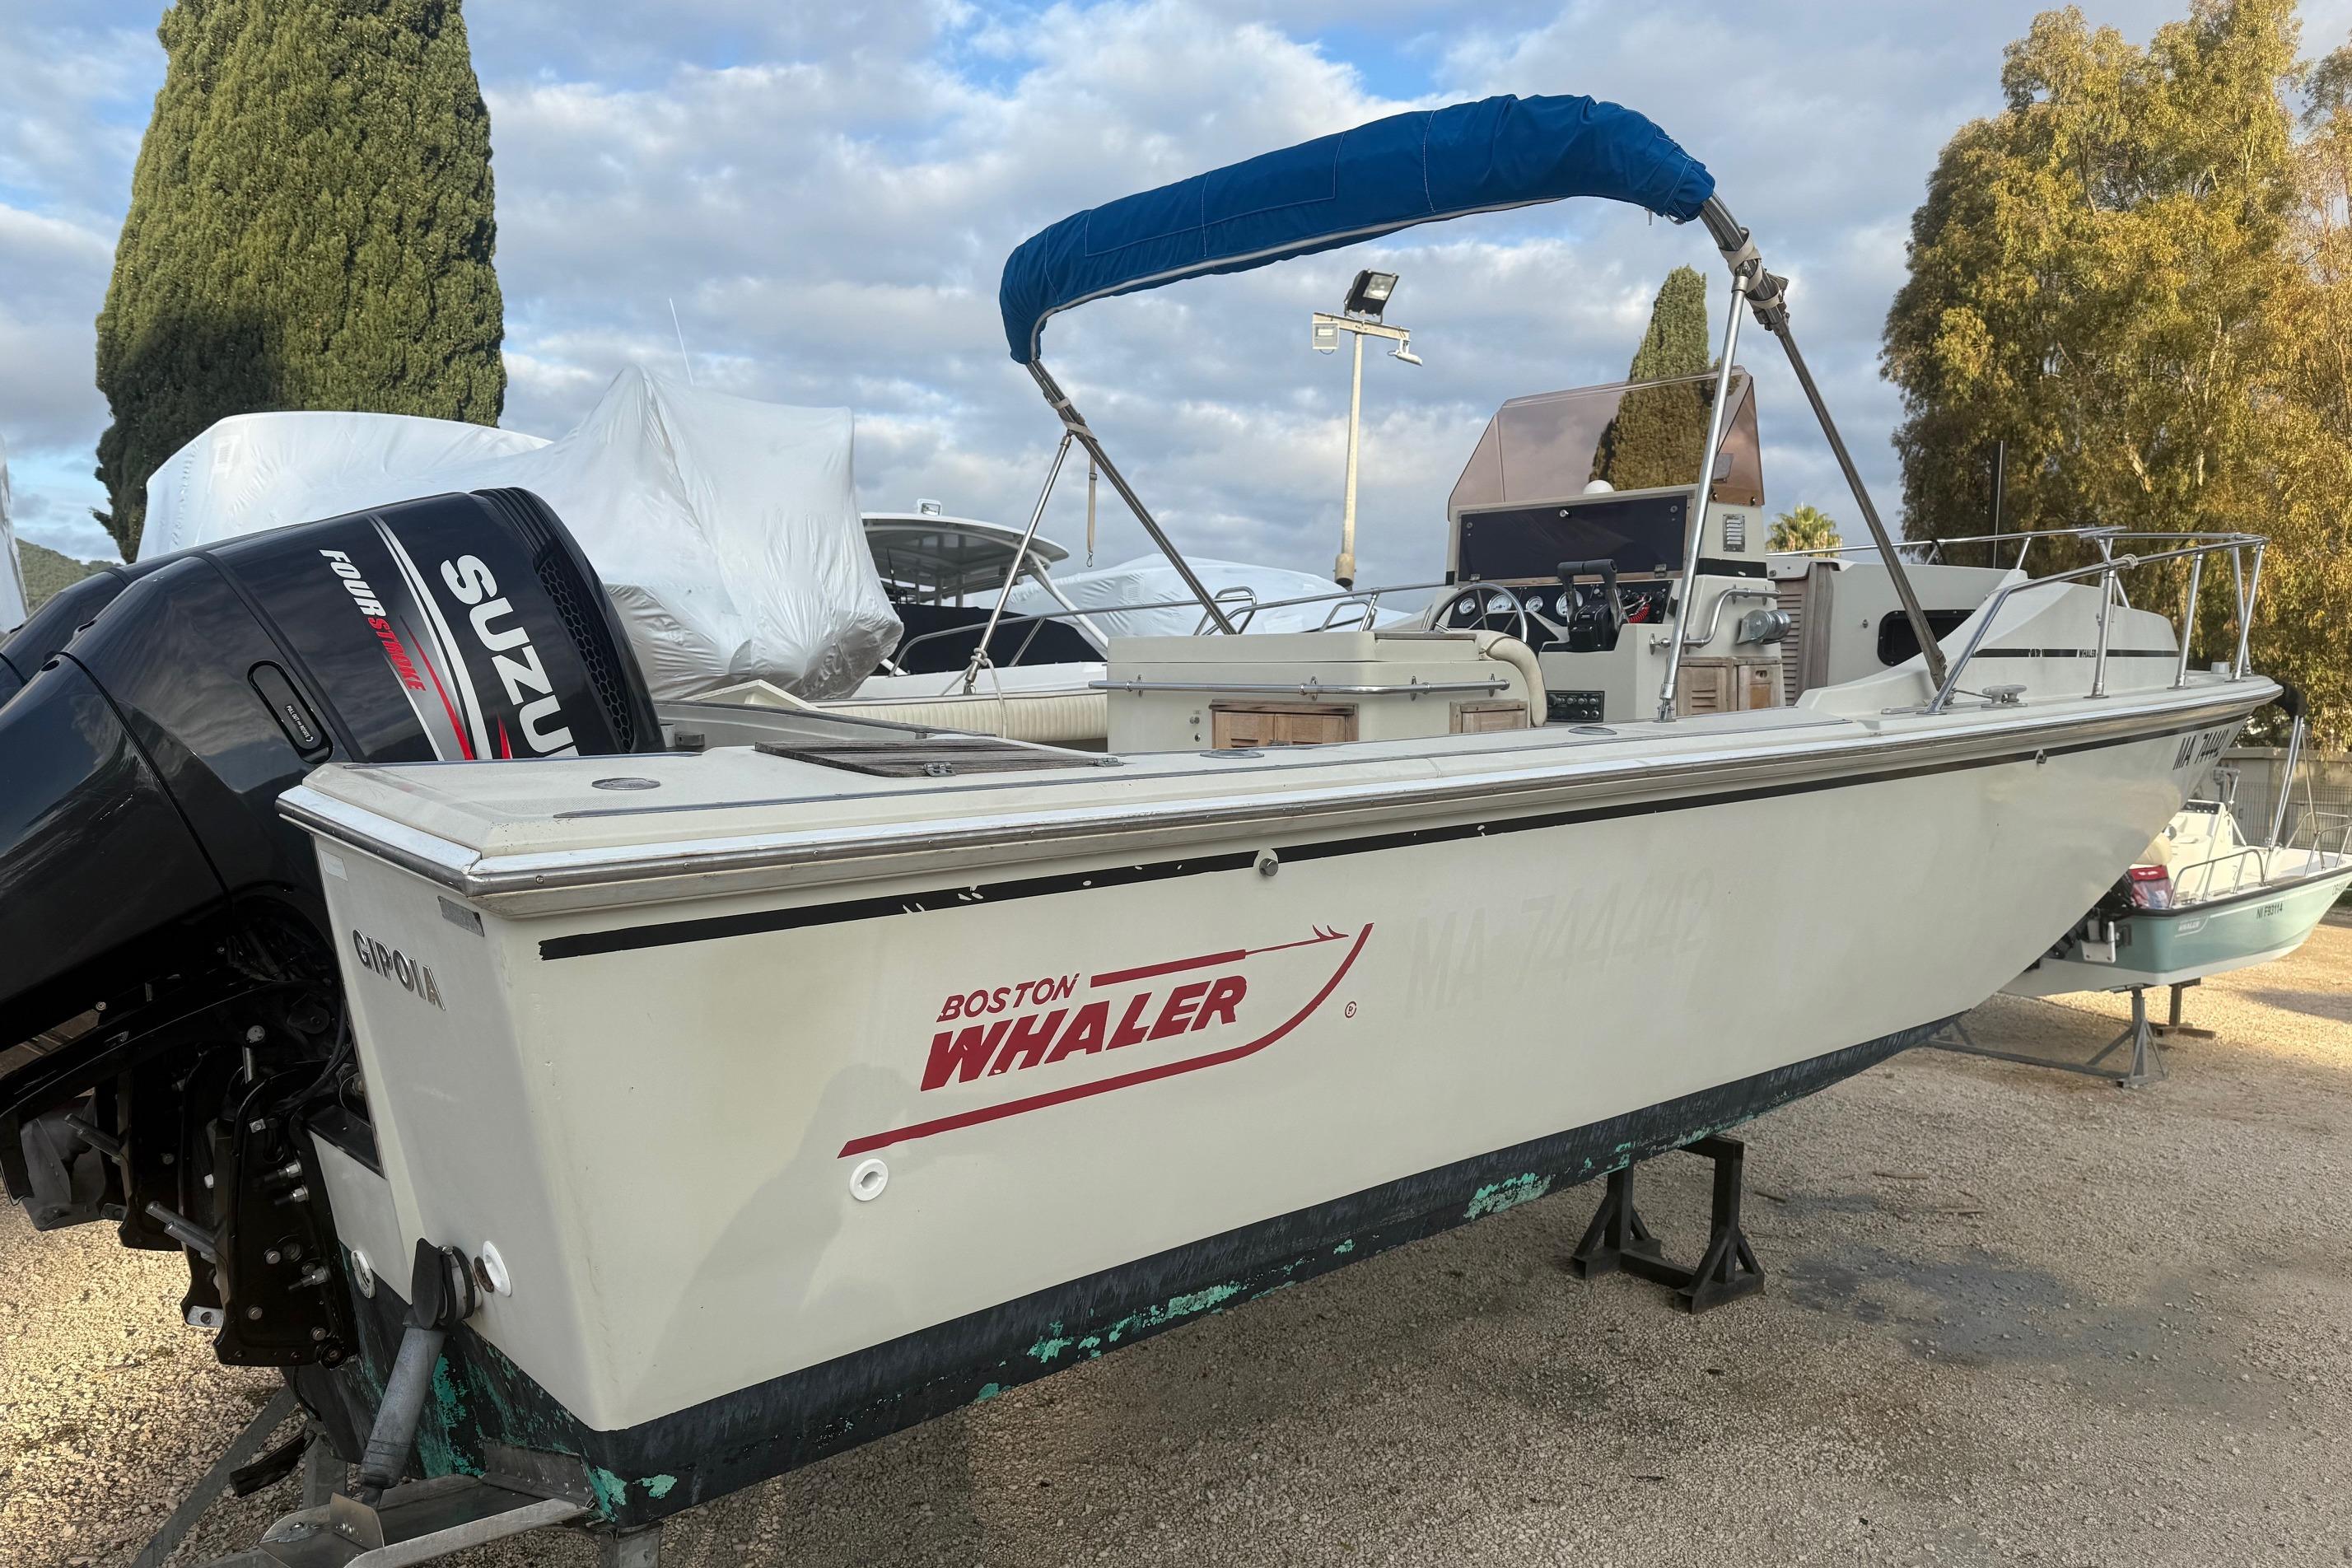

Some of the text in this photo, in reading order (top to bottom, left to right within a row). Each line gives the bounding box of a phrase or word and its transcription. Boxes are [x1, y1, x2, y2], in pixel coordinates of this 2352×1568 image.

[440, 554, 580, 758] SUZU
[2172, 735, 2196, 770] MA
[352, 928, 446, 1011] GIPOIA
[936, 973, 1080, 1023] BOSTON
[1402, 908, 1486, 1020] MA
[920, 975, 1247, 1092] WHALER
